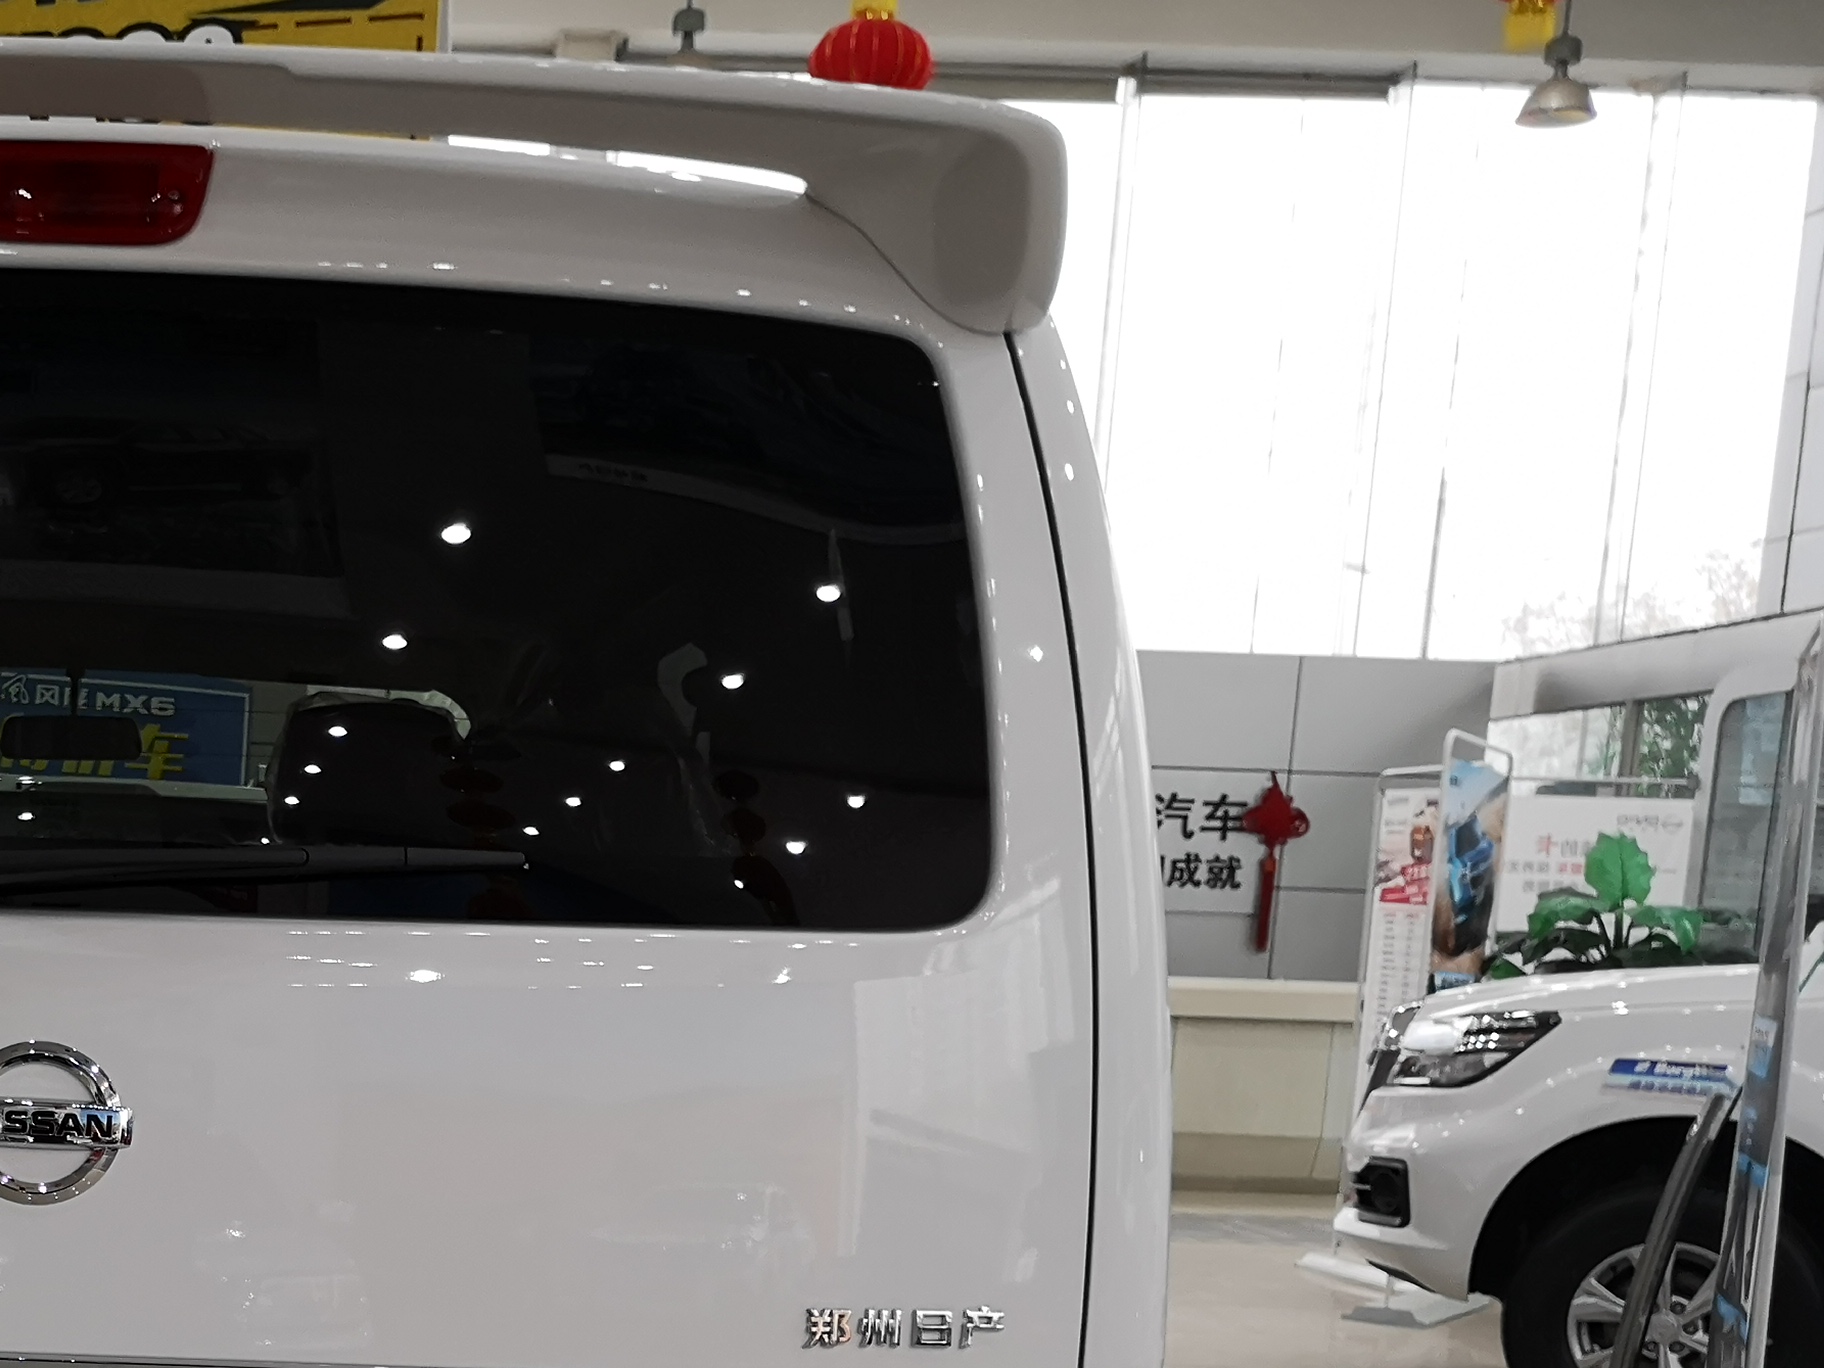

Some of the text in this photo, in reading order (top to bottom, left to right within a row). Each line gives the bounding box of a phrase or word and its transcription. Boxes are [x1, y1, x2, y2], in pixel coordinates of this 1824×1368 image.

[1160, 852, 1242, 889] 成就
[802, 1306, 1005, 1349] 郑州日产
